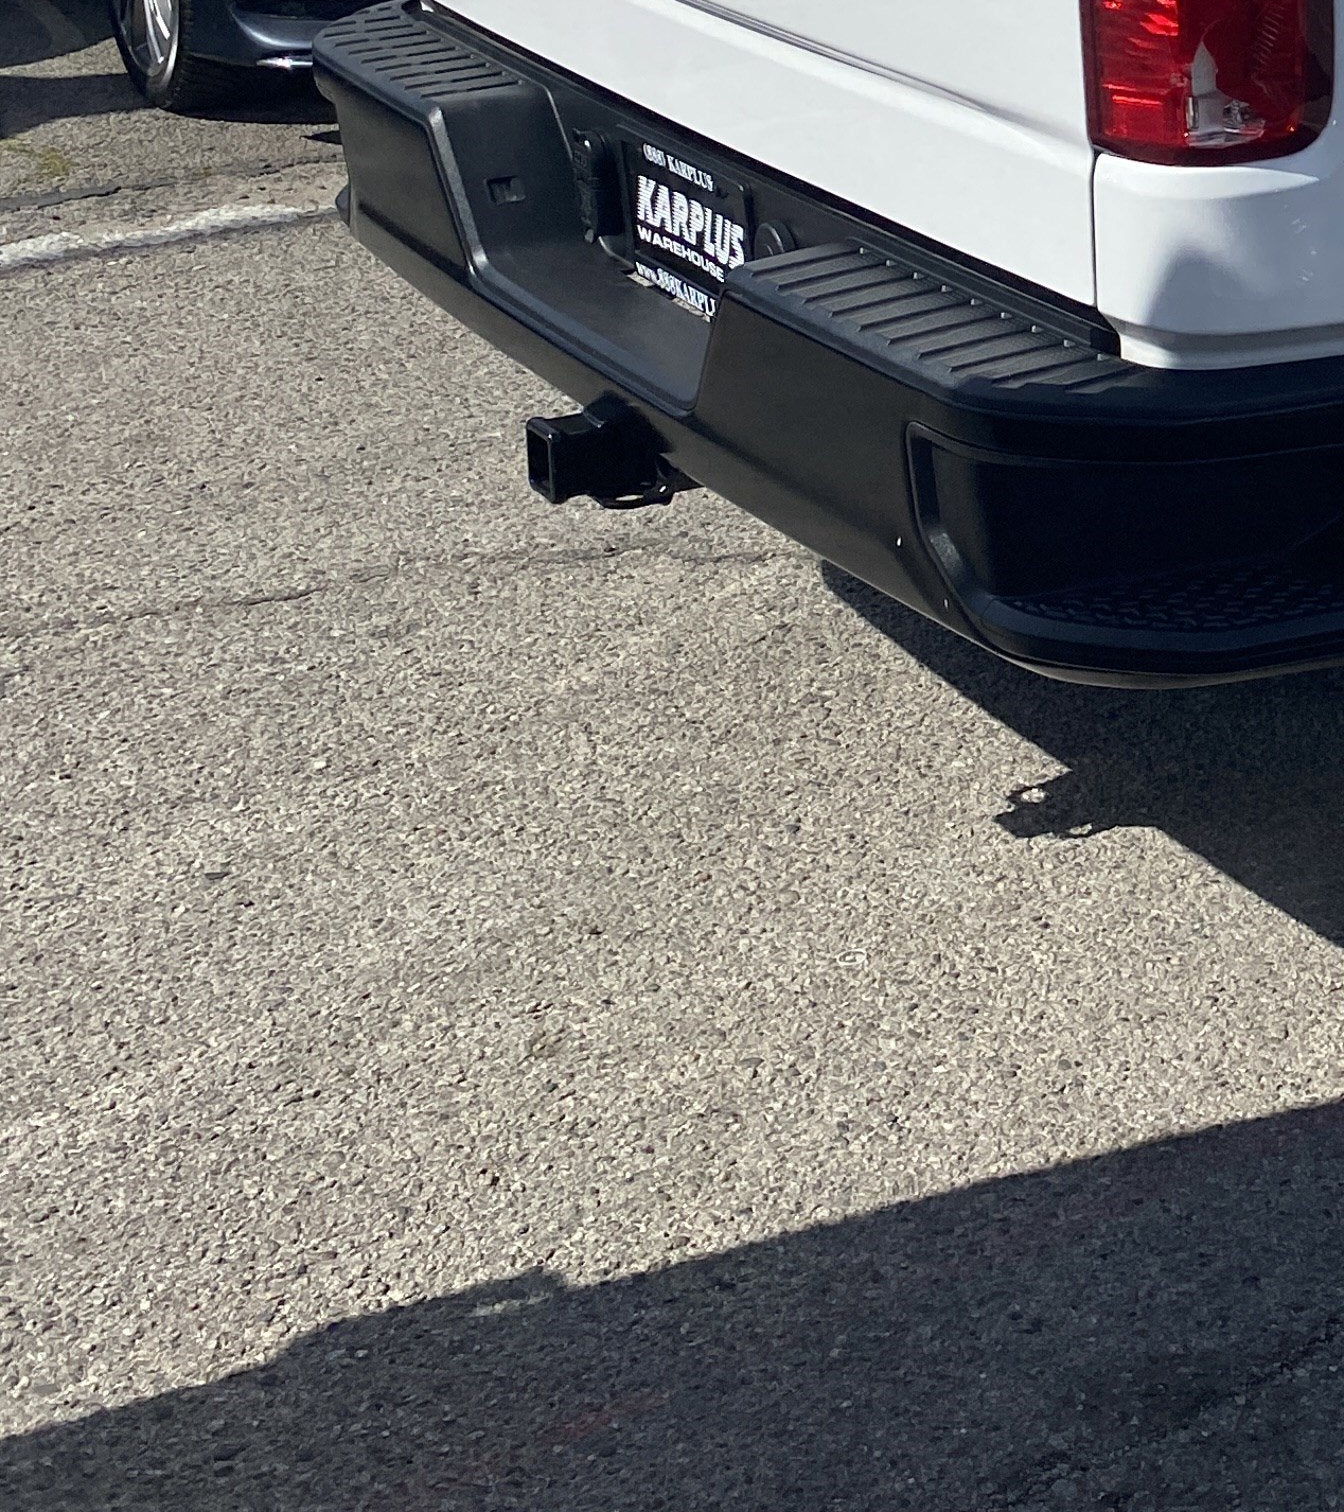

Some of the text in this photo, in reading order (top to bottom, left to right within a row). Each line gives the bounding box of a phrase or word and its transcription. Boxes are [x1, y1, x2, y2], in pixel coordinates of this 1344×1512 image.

[666, 154, 714, 192] KARPLUS
[636, 175, 745, 270] KARPLUS
[636, 224, 725, 283] WAREHOUSE
